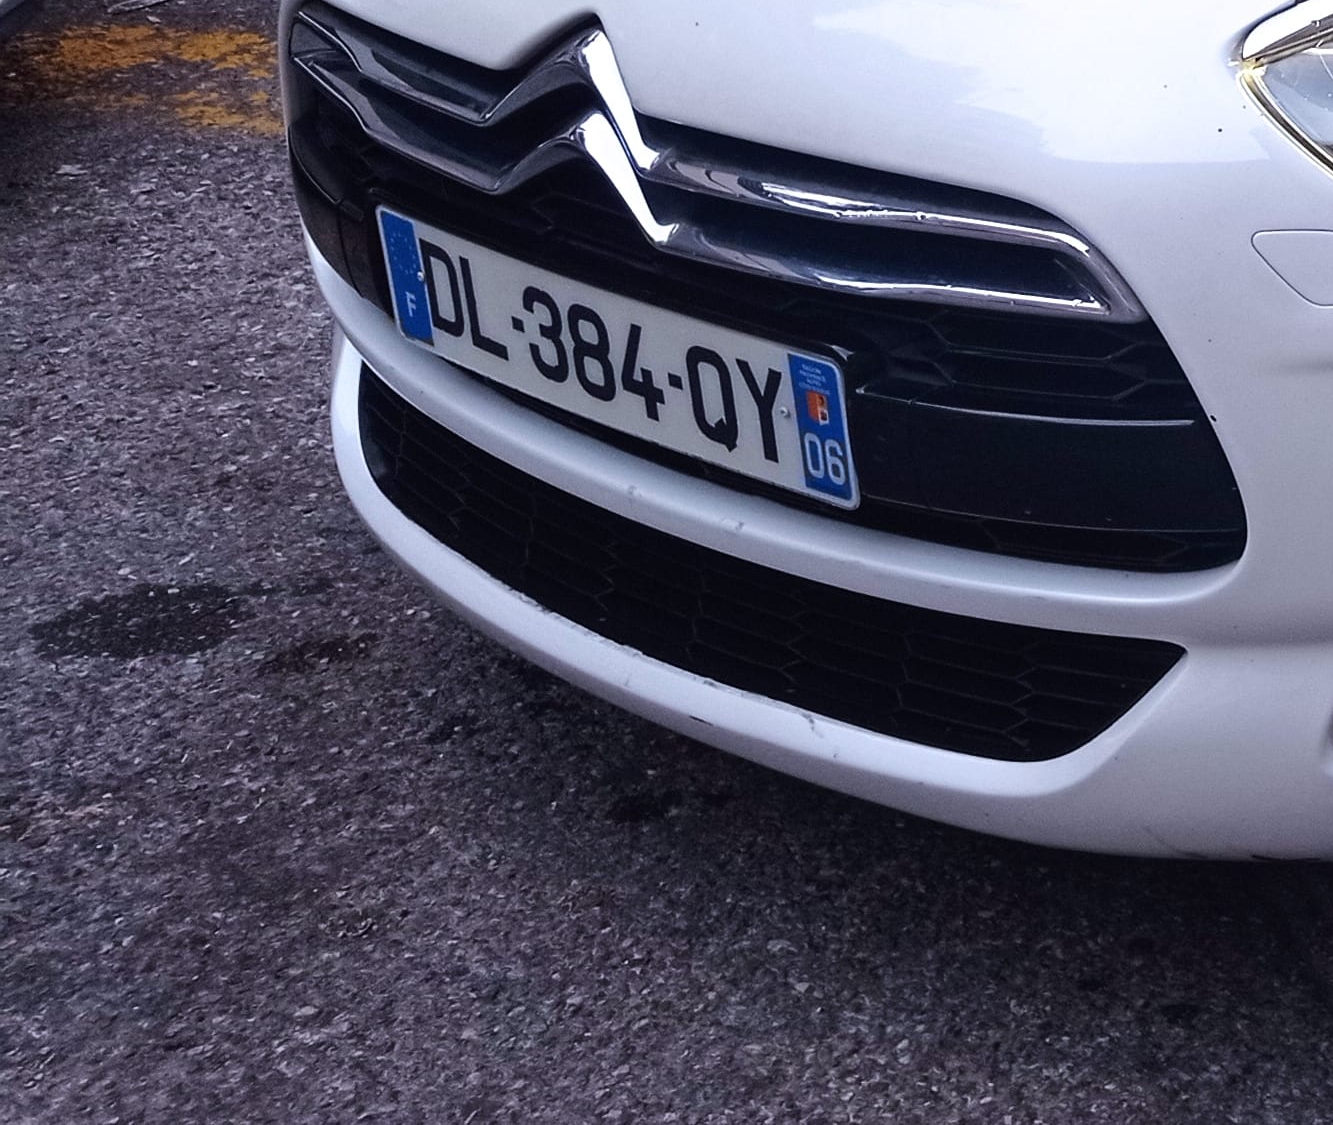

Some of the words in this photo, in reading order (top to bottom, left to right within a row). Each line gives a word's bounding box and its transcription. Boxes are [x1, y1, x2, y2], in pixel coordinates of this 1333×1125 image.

[404, 290, 416, 317] F
[418, 238, 783, 464] DL-384-QY
[804, 432, 846, 486] 06
